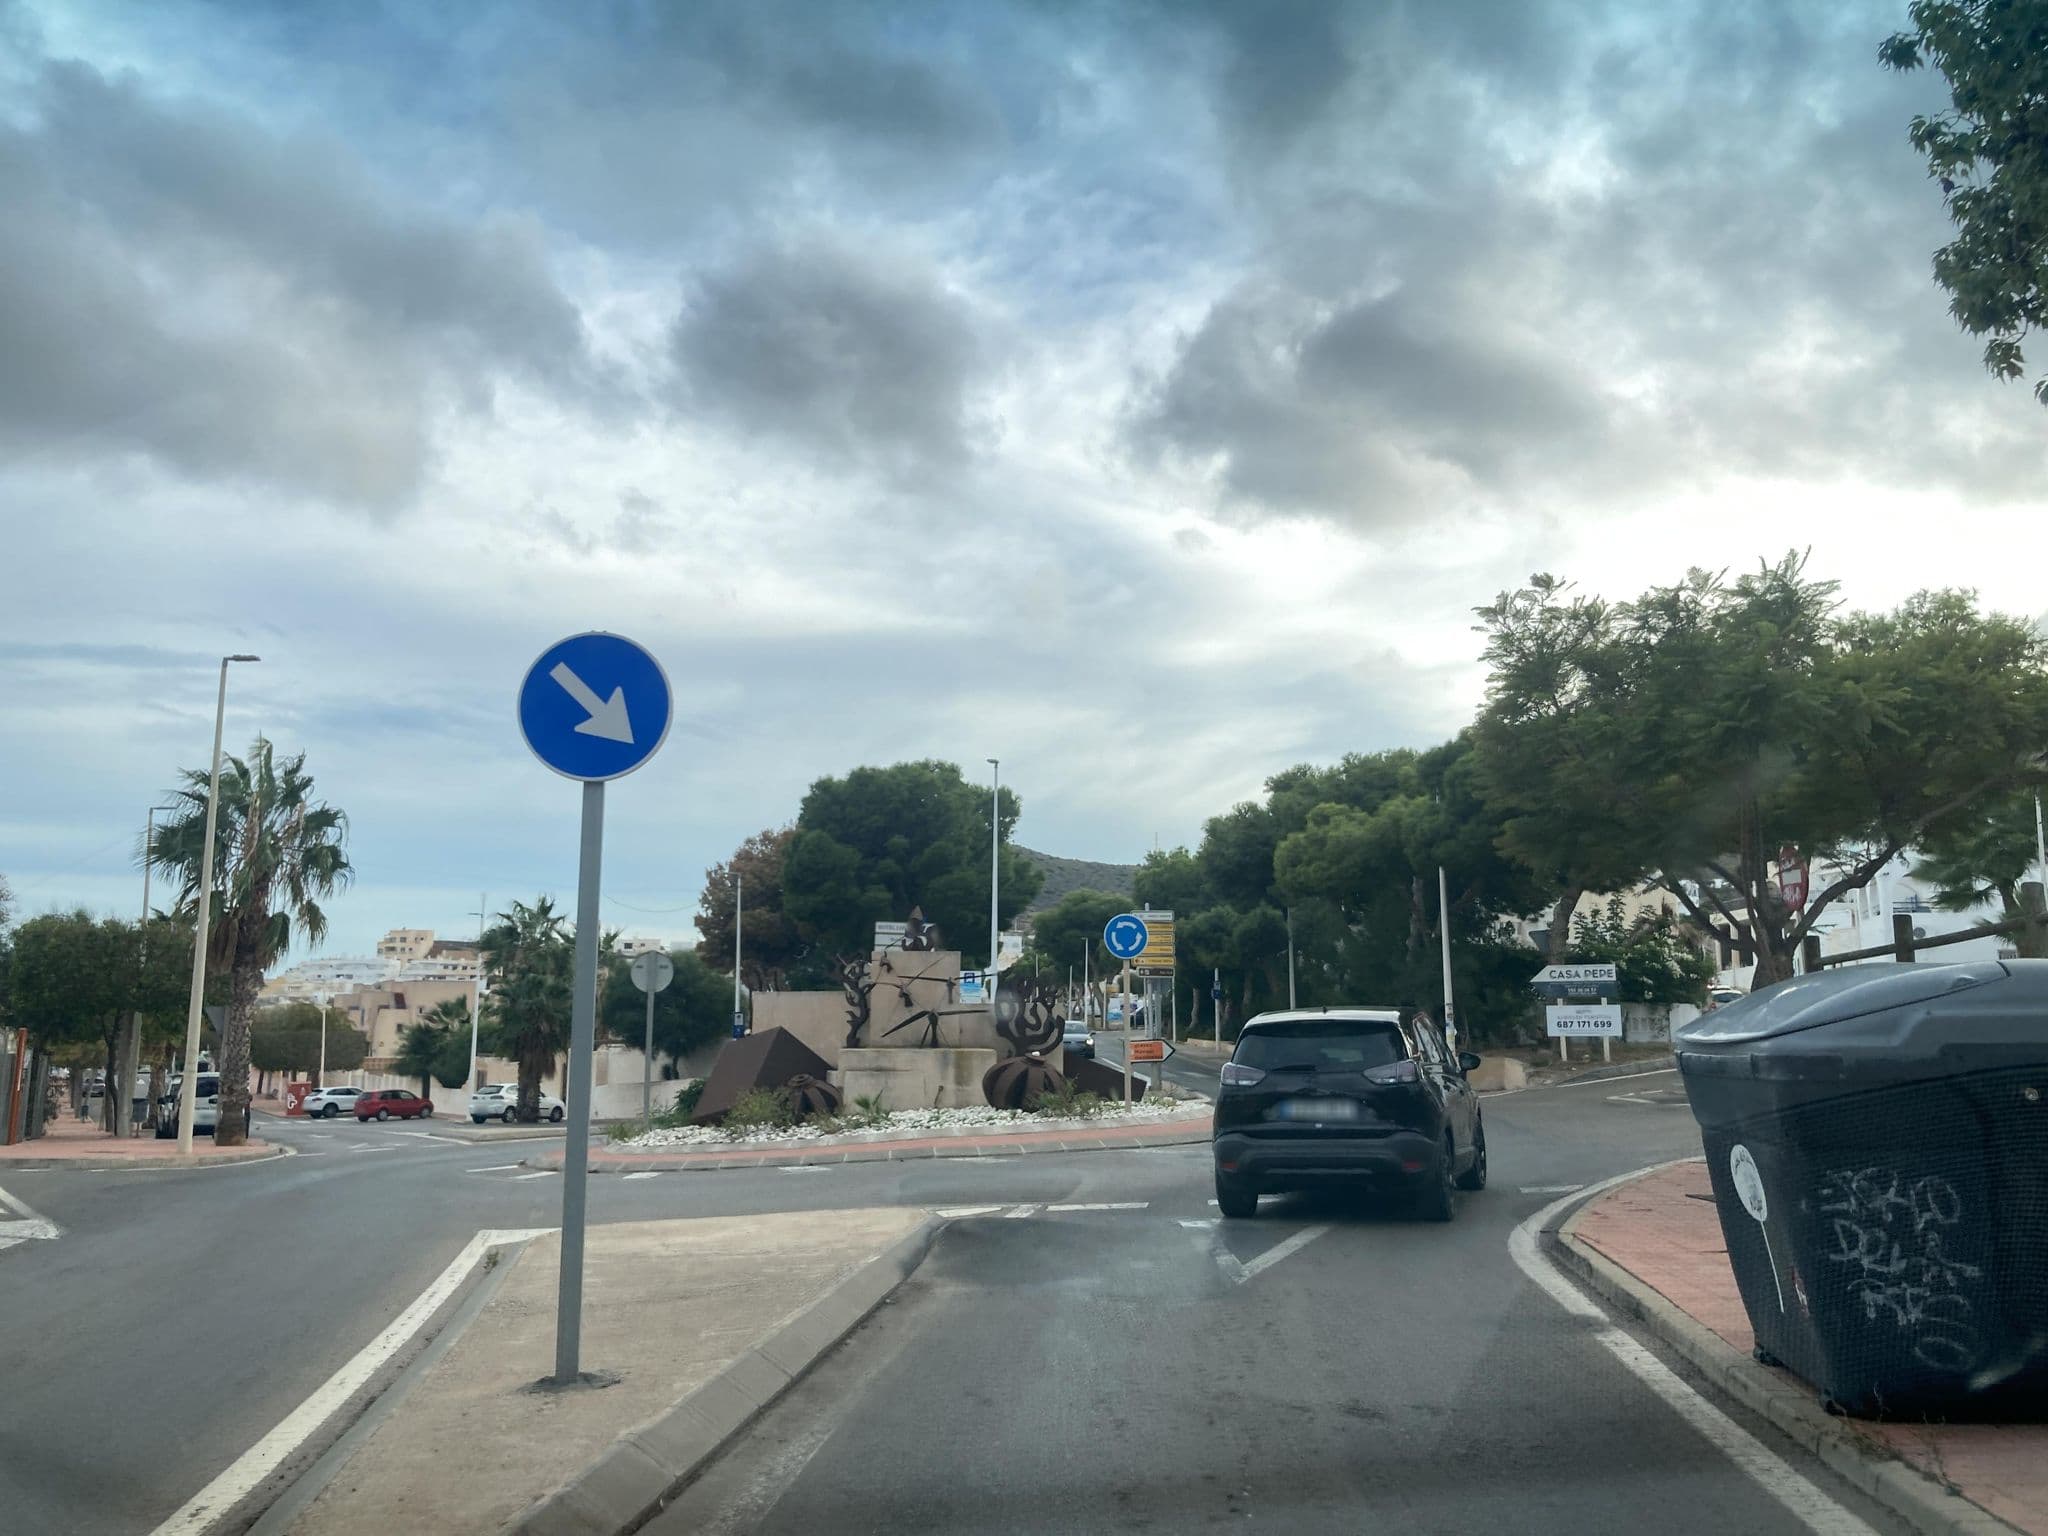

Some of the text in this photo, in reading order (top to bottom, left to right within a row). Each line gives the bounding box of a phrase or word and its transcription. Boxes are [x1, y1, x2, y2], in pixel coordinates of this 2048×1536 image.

[1549, 968, 1614, 979] CASA PEPE
[1557, 1020, 1612, 1028] 687 171 699
